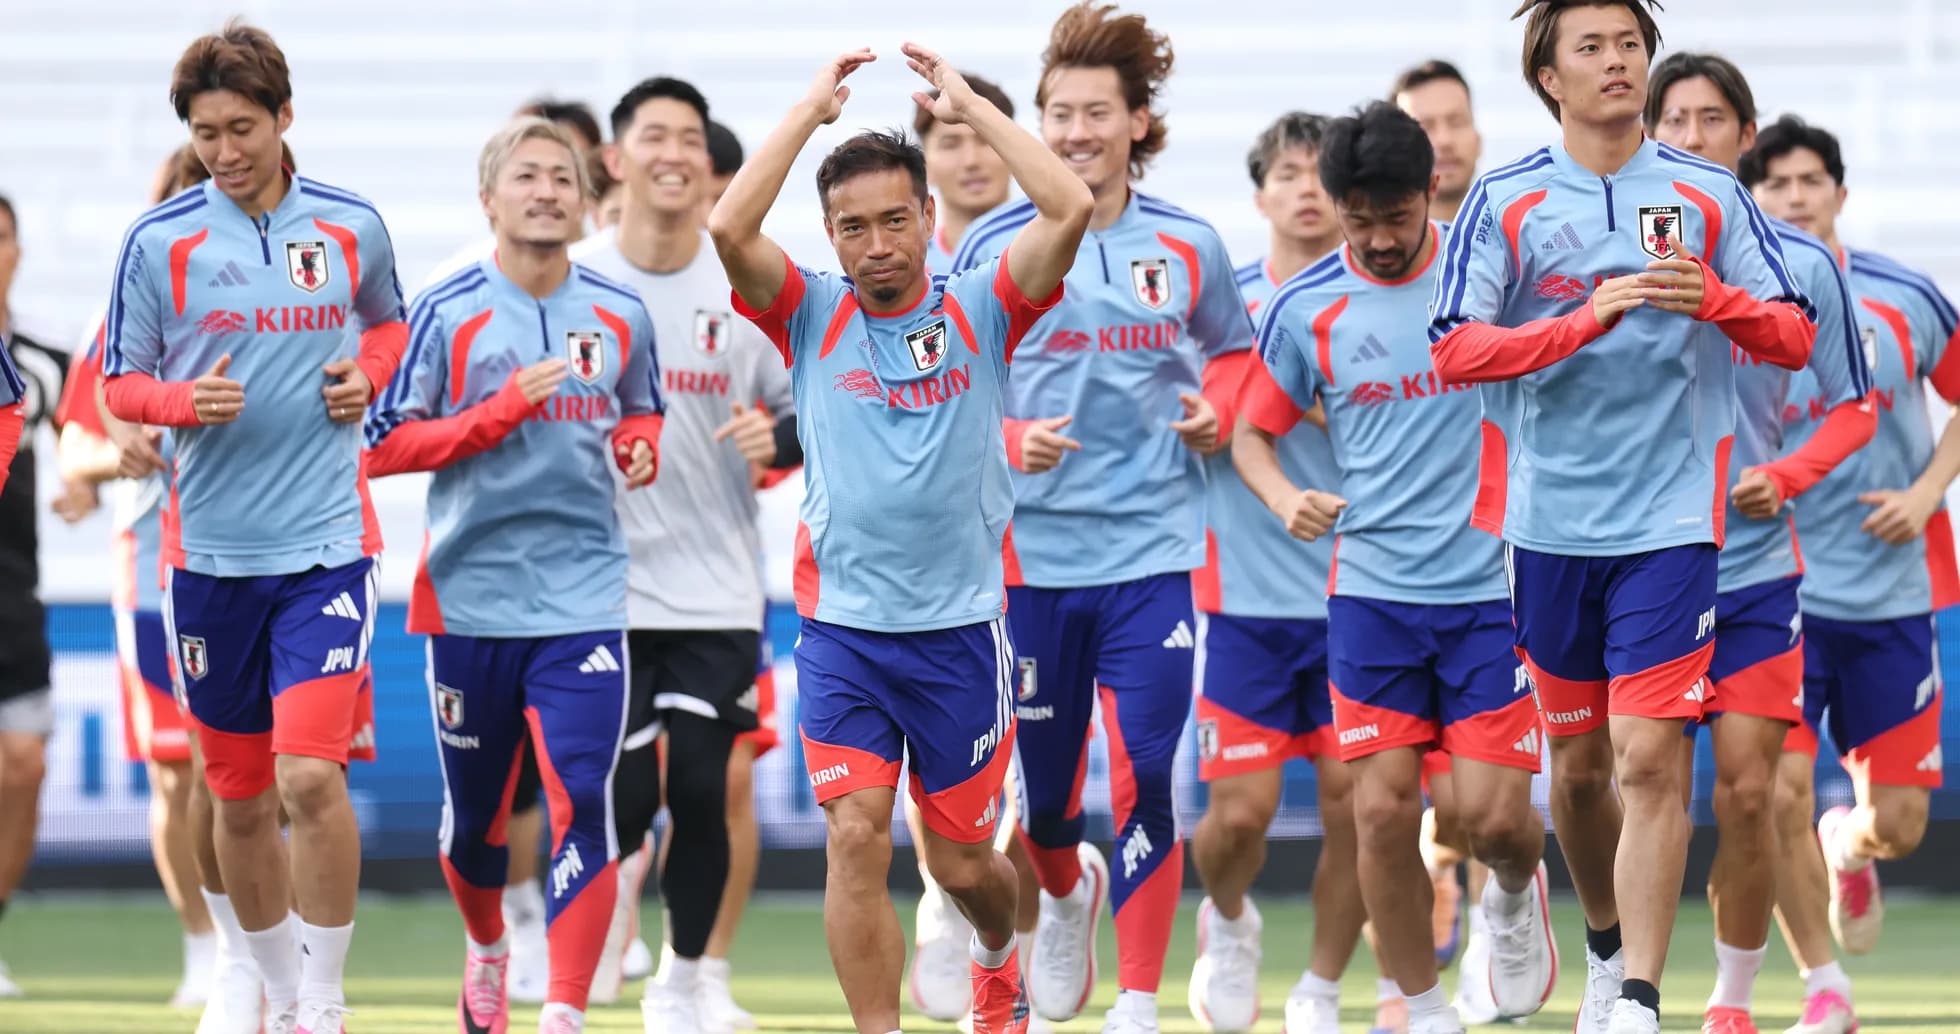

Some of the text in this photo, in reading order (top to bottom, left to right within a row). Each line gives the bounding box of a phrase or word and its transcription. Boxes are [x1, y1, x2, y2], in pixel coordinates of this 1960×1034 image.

[255, 303, 347, 334] KIRIN
[1097, 320, 1181, 353] KIRIN
[665, 368, 731, 397] IRIN
[887, 363, 972, 410] KIRIN
[321, 646, 355, 674] JPN
[1513, 663, 1528, 694] JP
[1546, 705, 1593, 725] KIRIN
[970, 724, 997, 767] JPN
[1339, 723, 1380, 746] KIRIN
[810, 762, 850, 787] KIRIN
[1122, 823, 1153, 879] JPN
[552, 842, 584, 899] JPN
